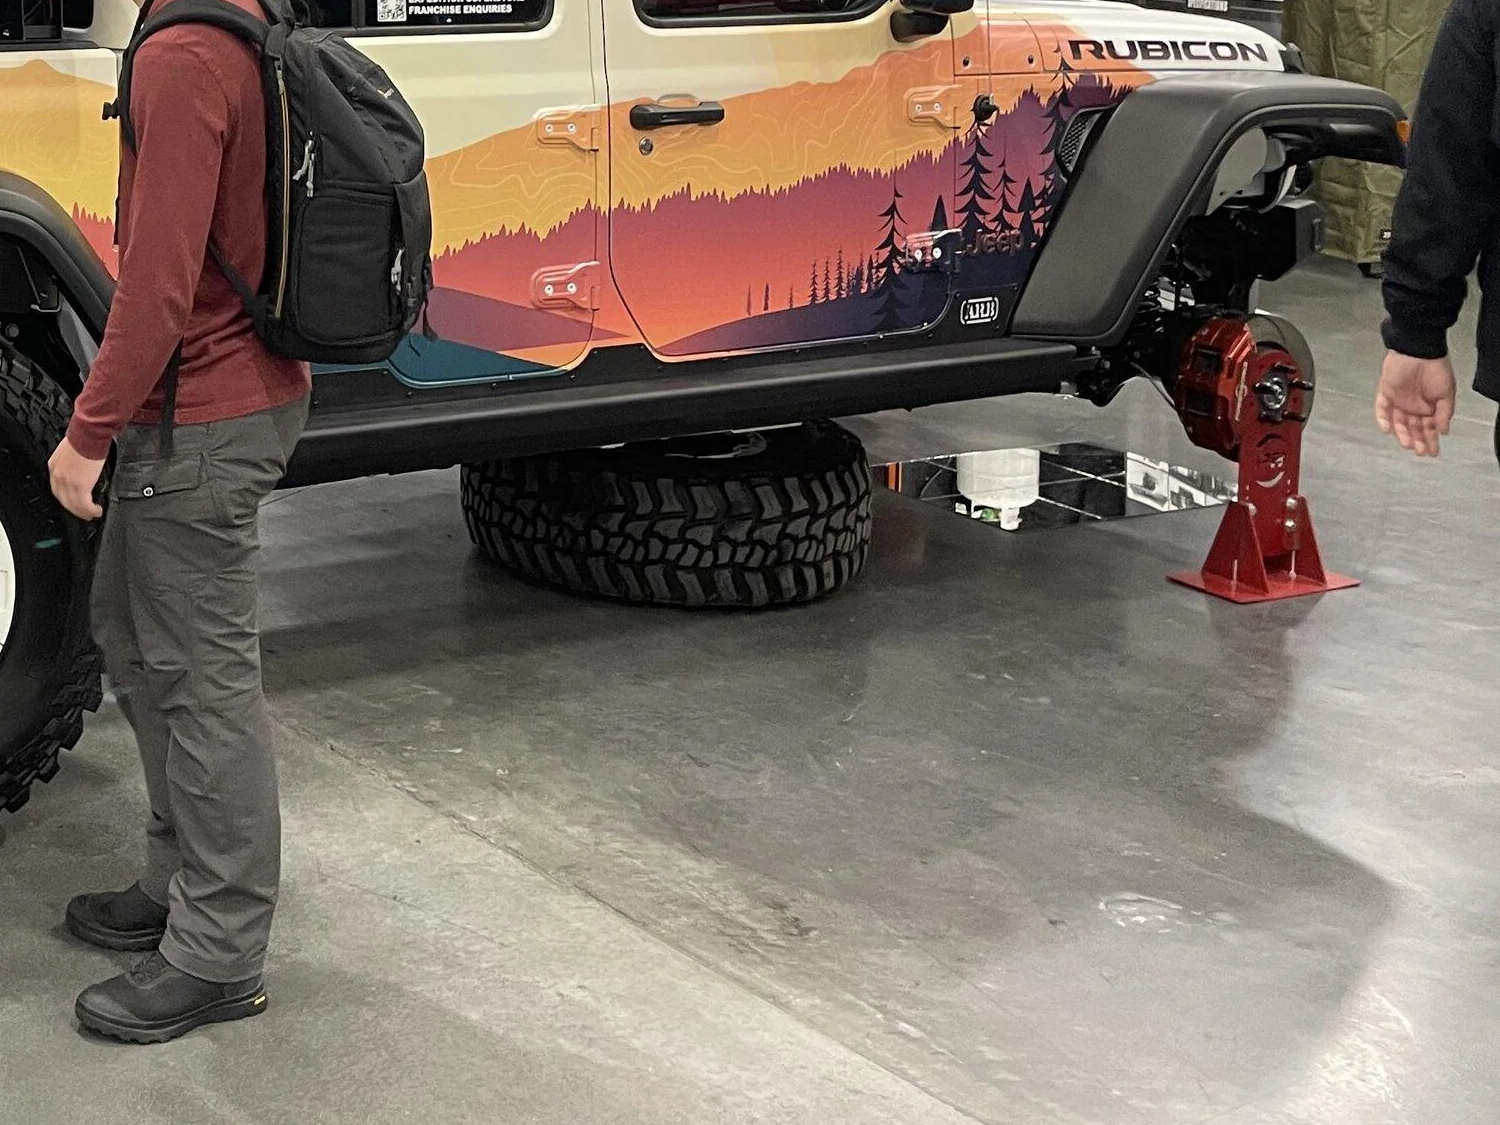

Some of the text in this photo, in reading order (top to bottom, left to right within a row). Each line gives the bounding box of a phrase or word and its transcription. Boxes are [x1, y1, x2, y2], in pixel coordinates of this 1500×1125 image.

[408, 4, 513, 15] FRANCHISE ENQUIRIES
[1068, 40, 1268, 61] RUBICON
